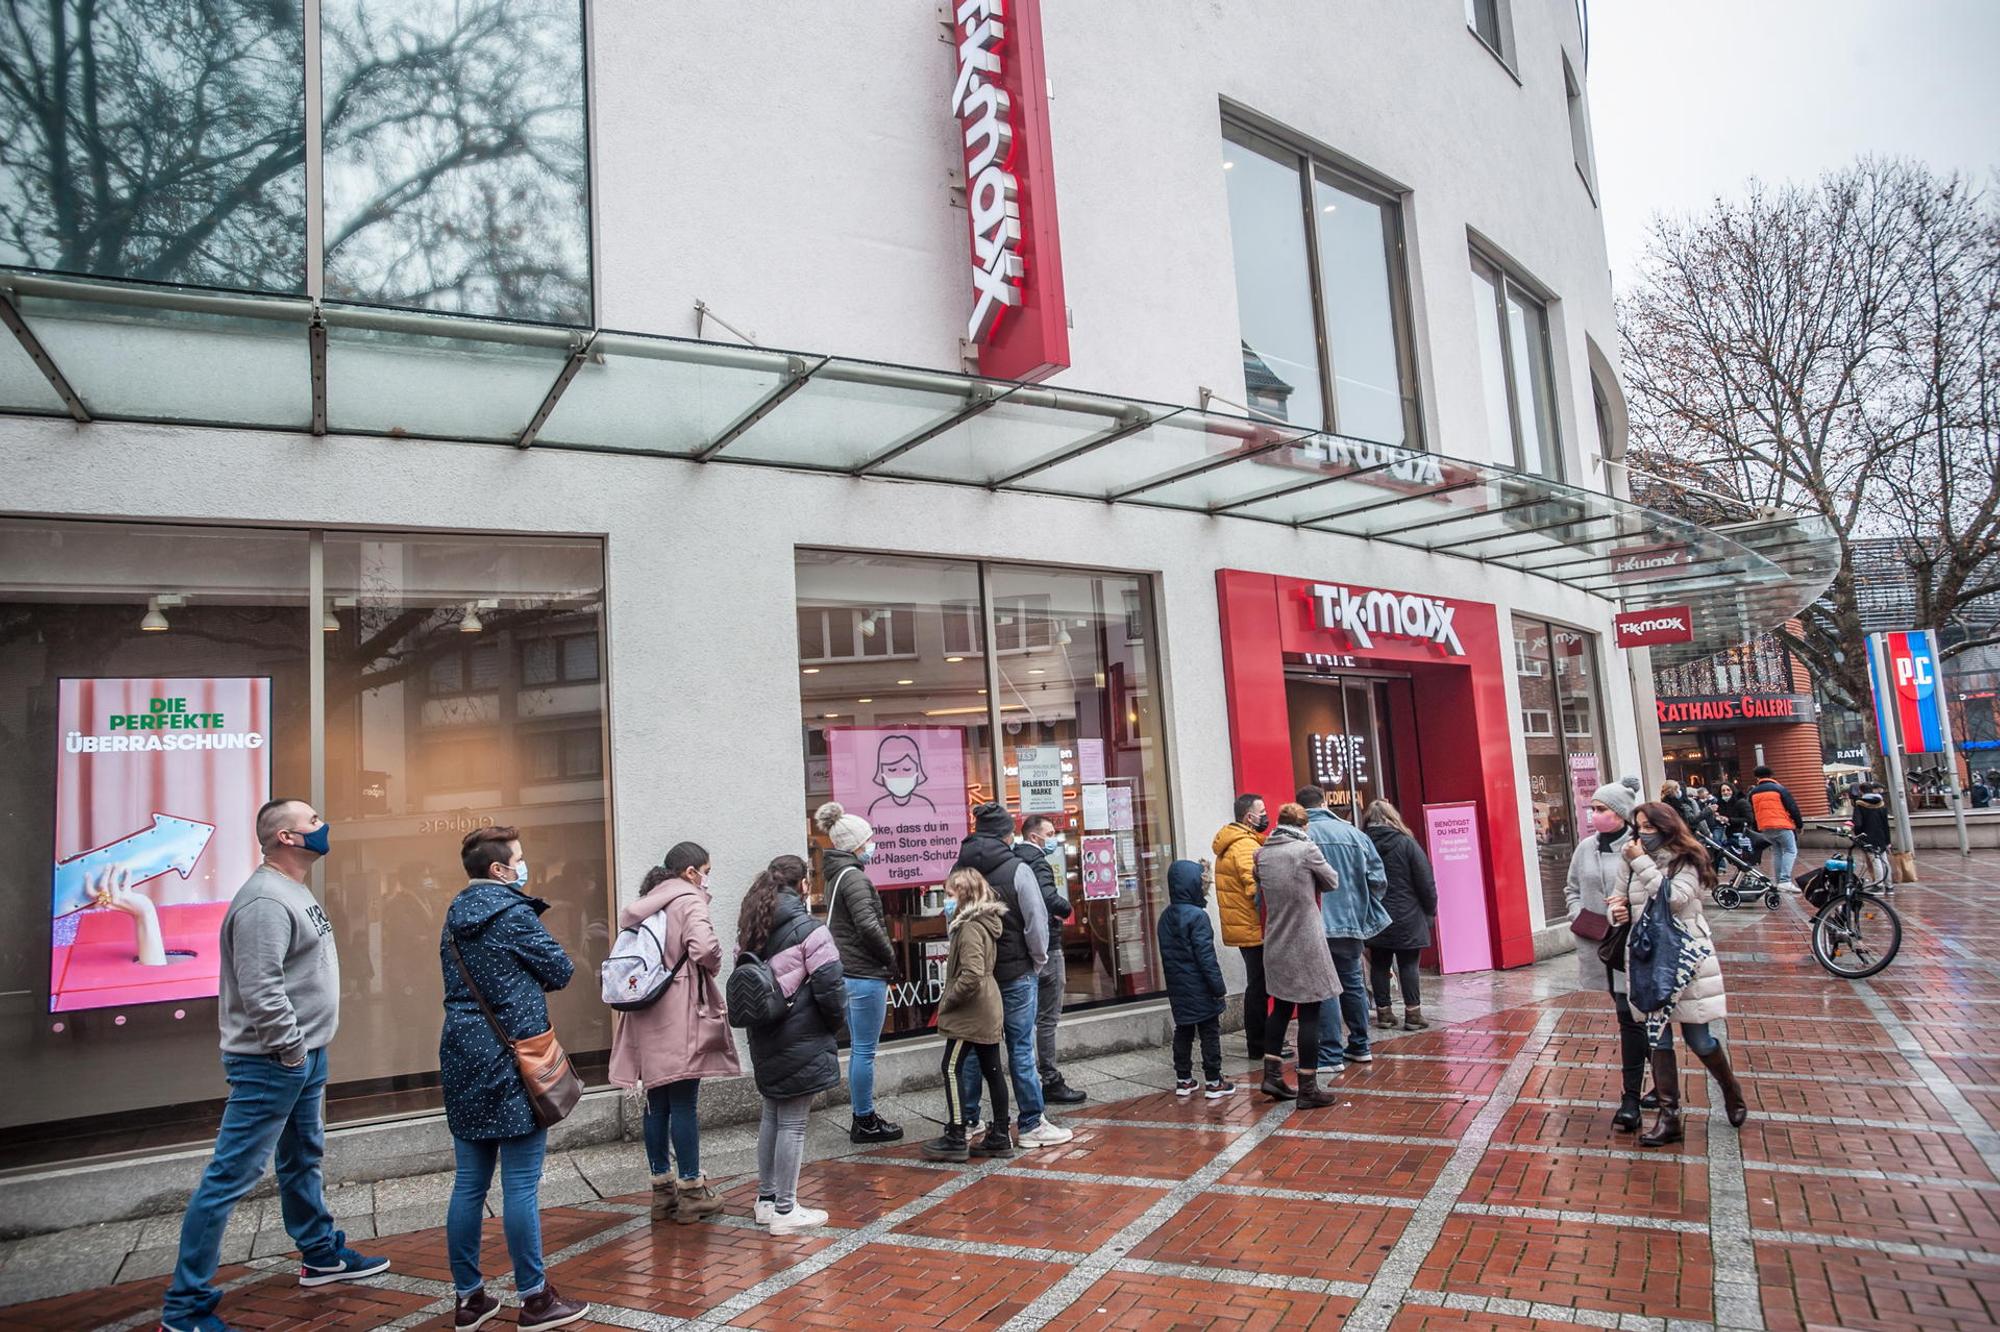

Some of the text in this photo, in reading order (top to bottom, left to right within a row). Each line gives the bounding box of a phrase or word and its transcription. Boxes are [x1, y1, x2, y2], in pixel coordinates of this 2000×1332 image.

[150, 697, 187, 713] DIE
[109, 713, 225, 731] PERFEKTE
[66, 731, 264, 753] ÜBERRASCHUNG
[1314, 733, 1368, 784] LOVE
[1022, 779, 1060, 787] BELIEBTESTE
[871, 822, 949, 835] nke, dass du in
[1434, 819, 1470, 828] BENÖTIGST
[898, 838, 927, 848] Store
[930, 836, 958, 846] einen
[889, 868, 923, 879] trägst.
